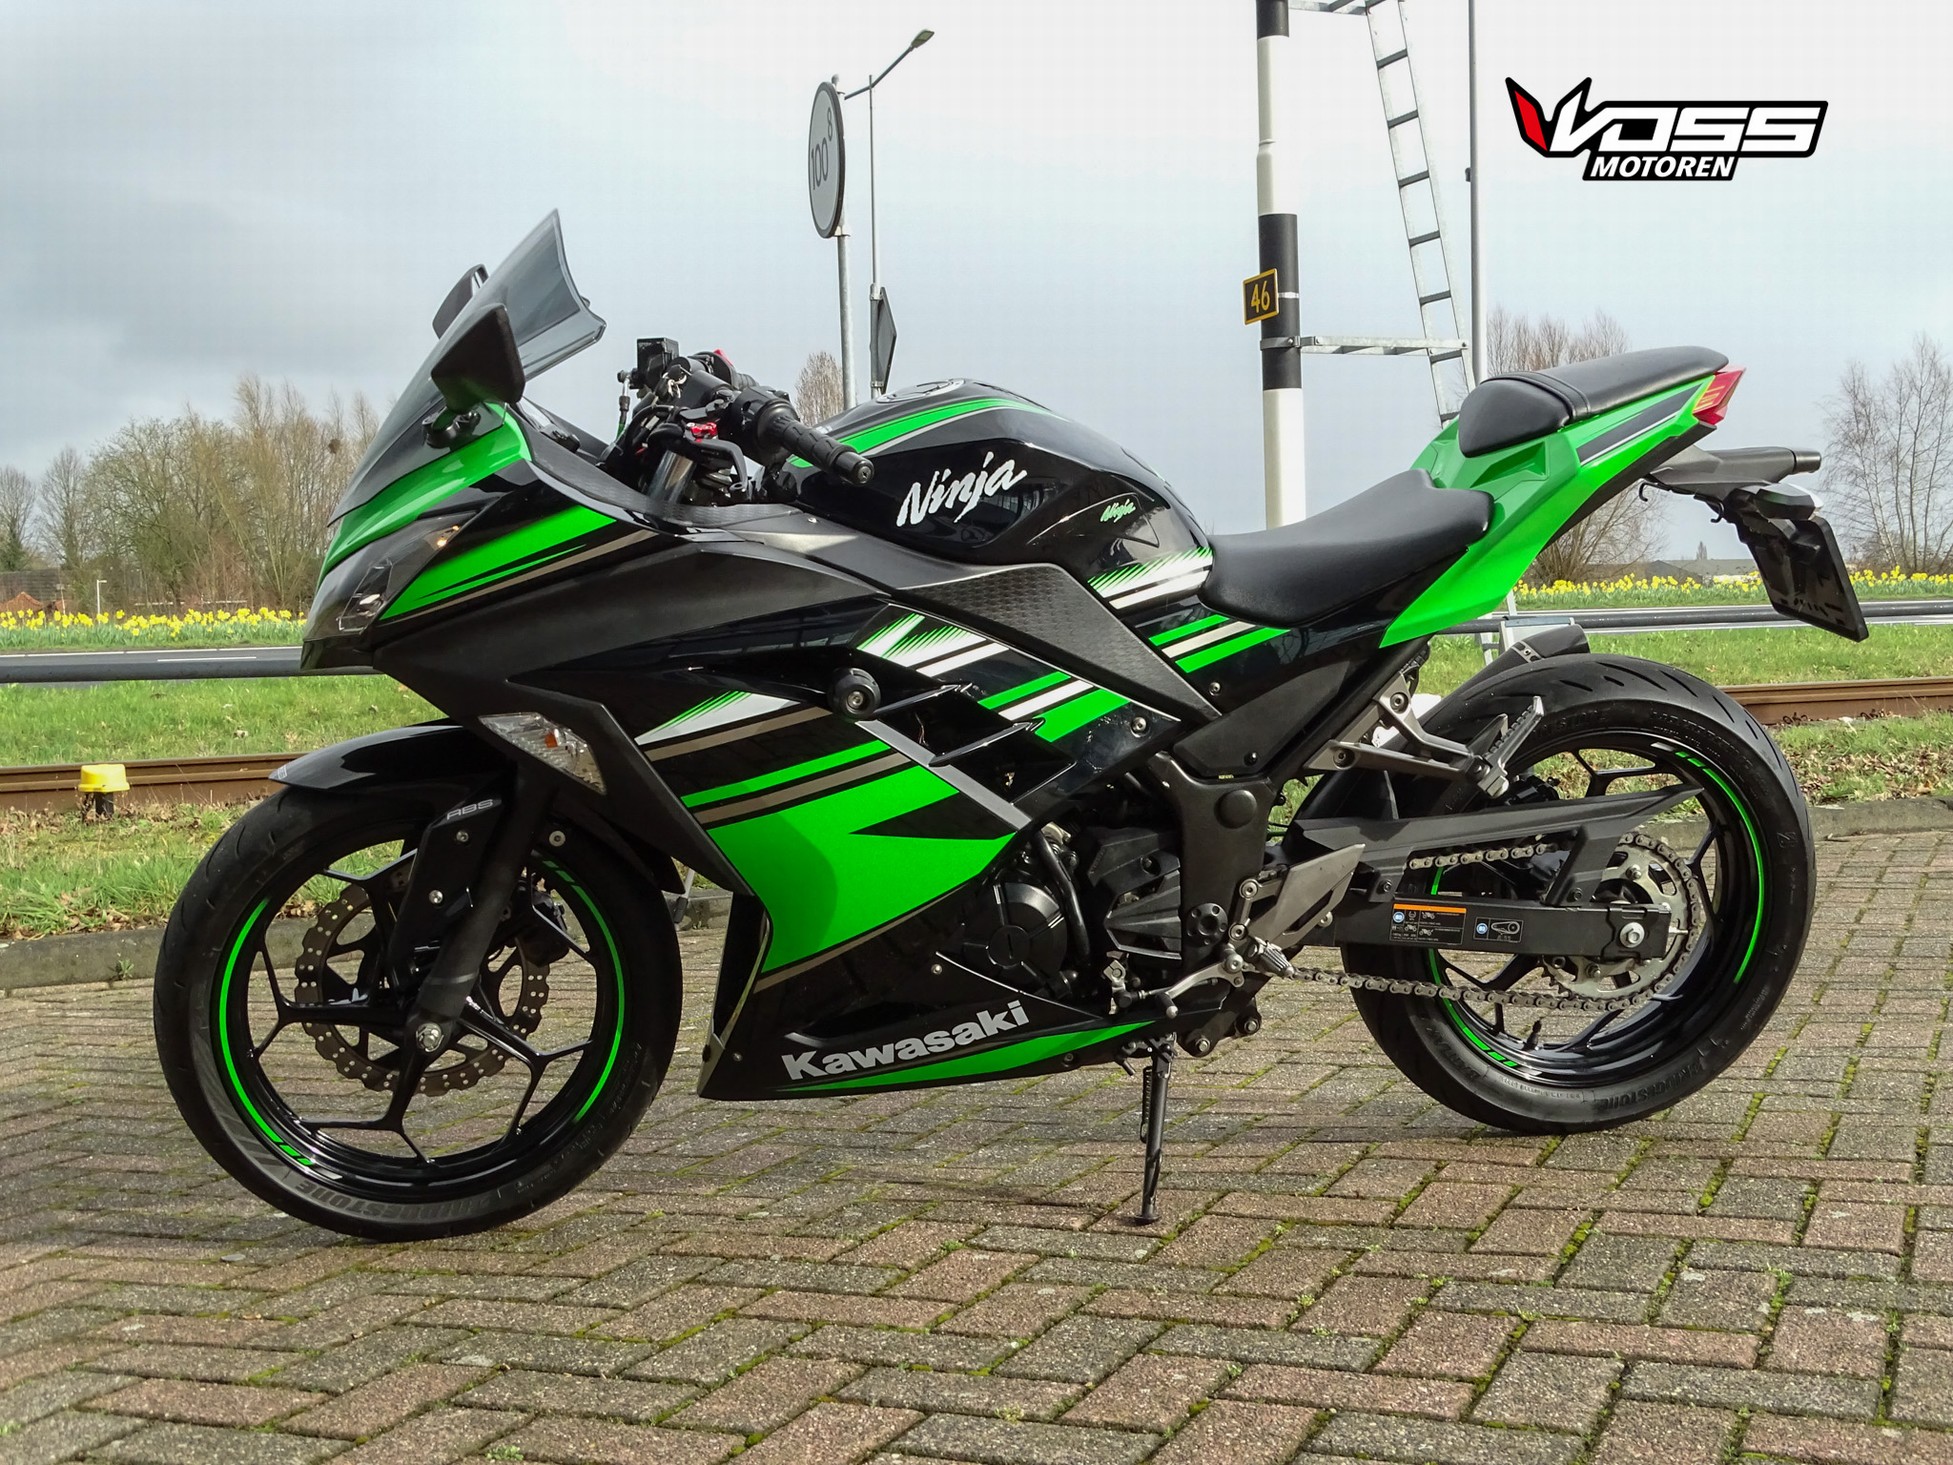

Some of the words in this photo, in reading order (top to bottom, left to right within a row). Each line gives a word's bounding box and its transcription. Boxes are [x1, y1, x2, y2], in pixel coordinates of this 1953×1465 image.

[810, 136, 829, 191] 100
[1250, 280, 1271, 313] 46
[896, 451, 1028, 528] Ninja
[1100, 498, 1136, 523] Ninja
[446, 798, 494, 821] ABS
[781, 1000, 1030, 1081] Kawasaki
